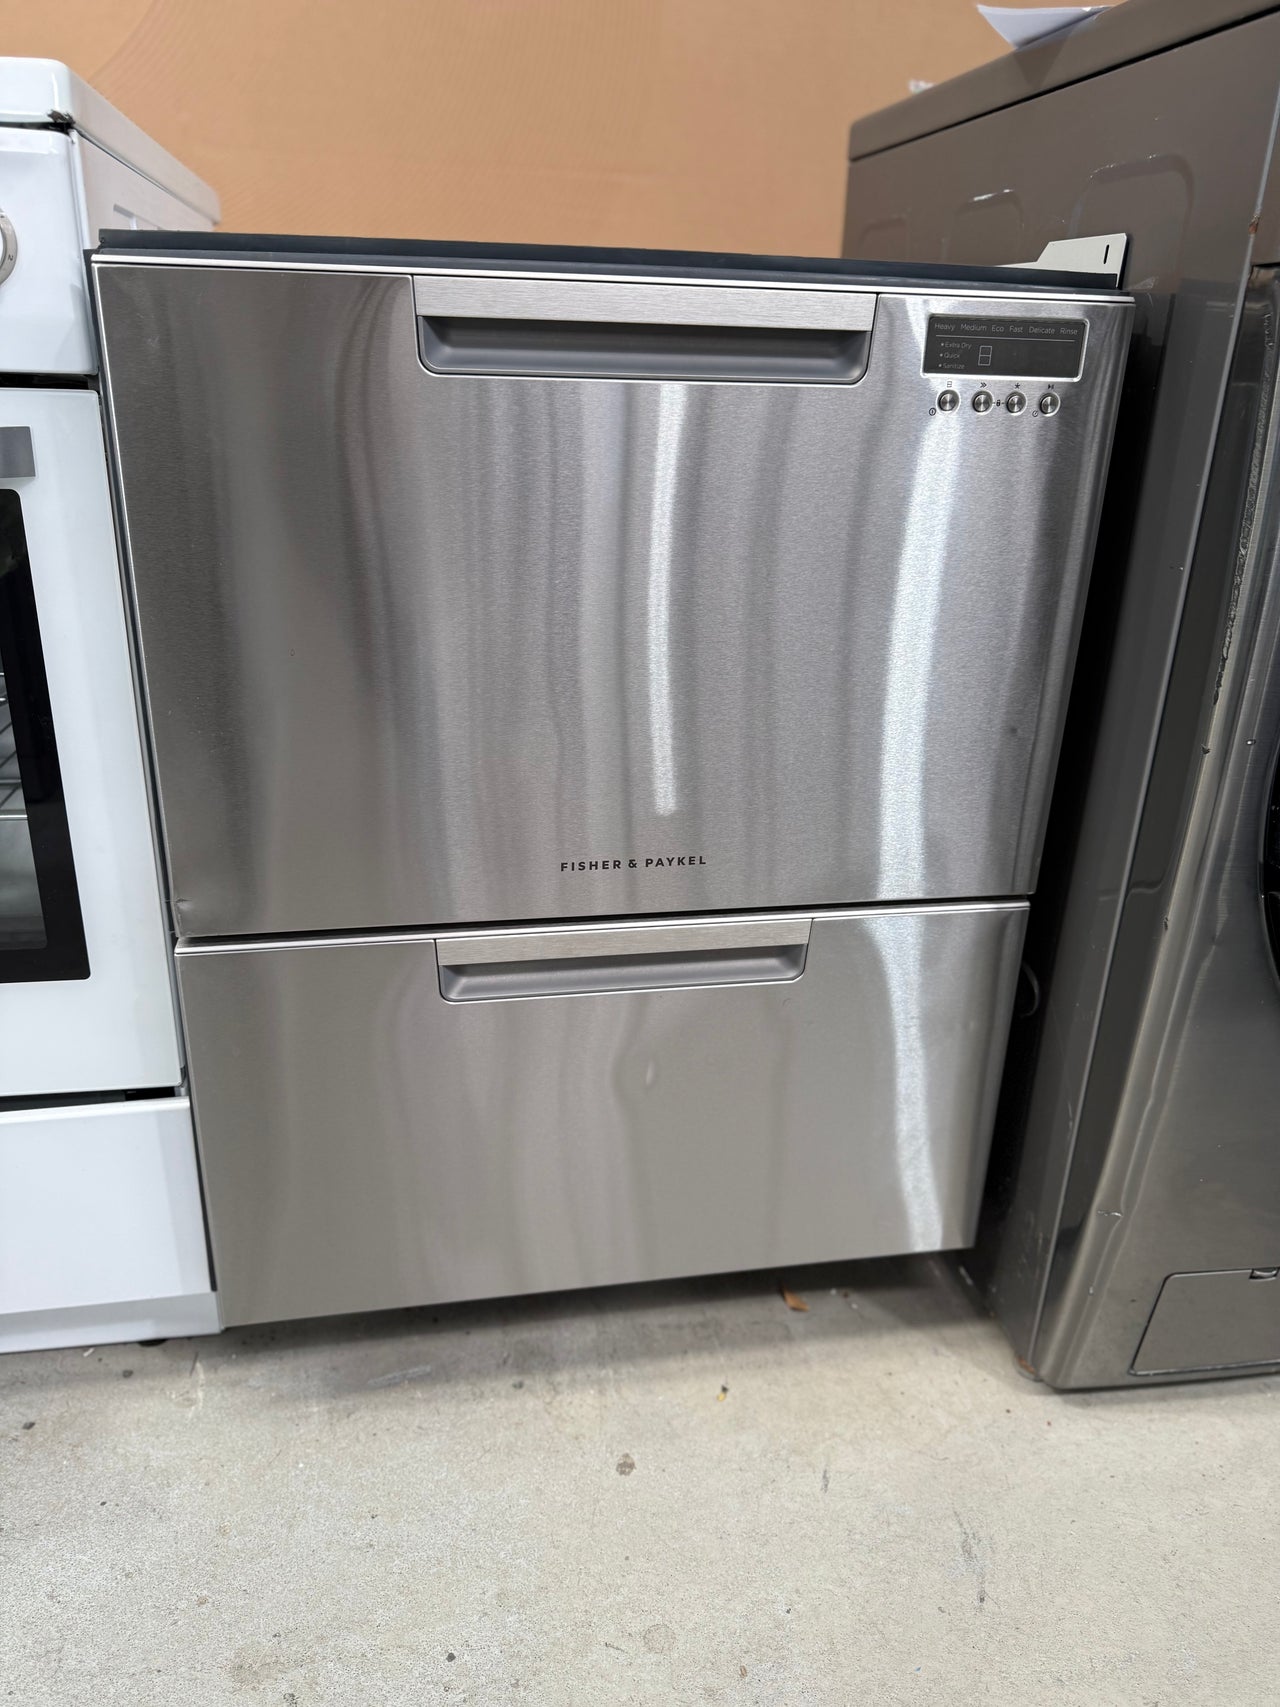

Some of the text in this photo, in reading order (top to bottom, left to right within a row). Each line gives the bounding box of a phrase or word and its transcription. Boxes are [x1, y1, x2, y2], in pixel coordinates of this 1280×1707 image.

[934, 323, 1078, 336] Heavy Medium Eco Fast Delicate Rinse
[961, 342, 972, 350] Dry
[560, 855, 707, 872] FISHER & PAYKEL
